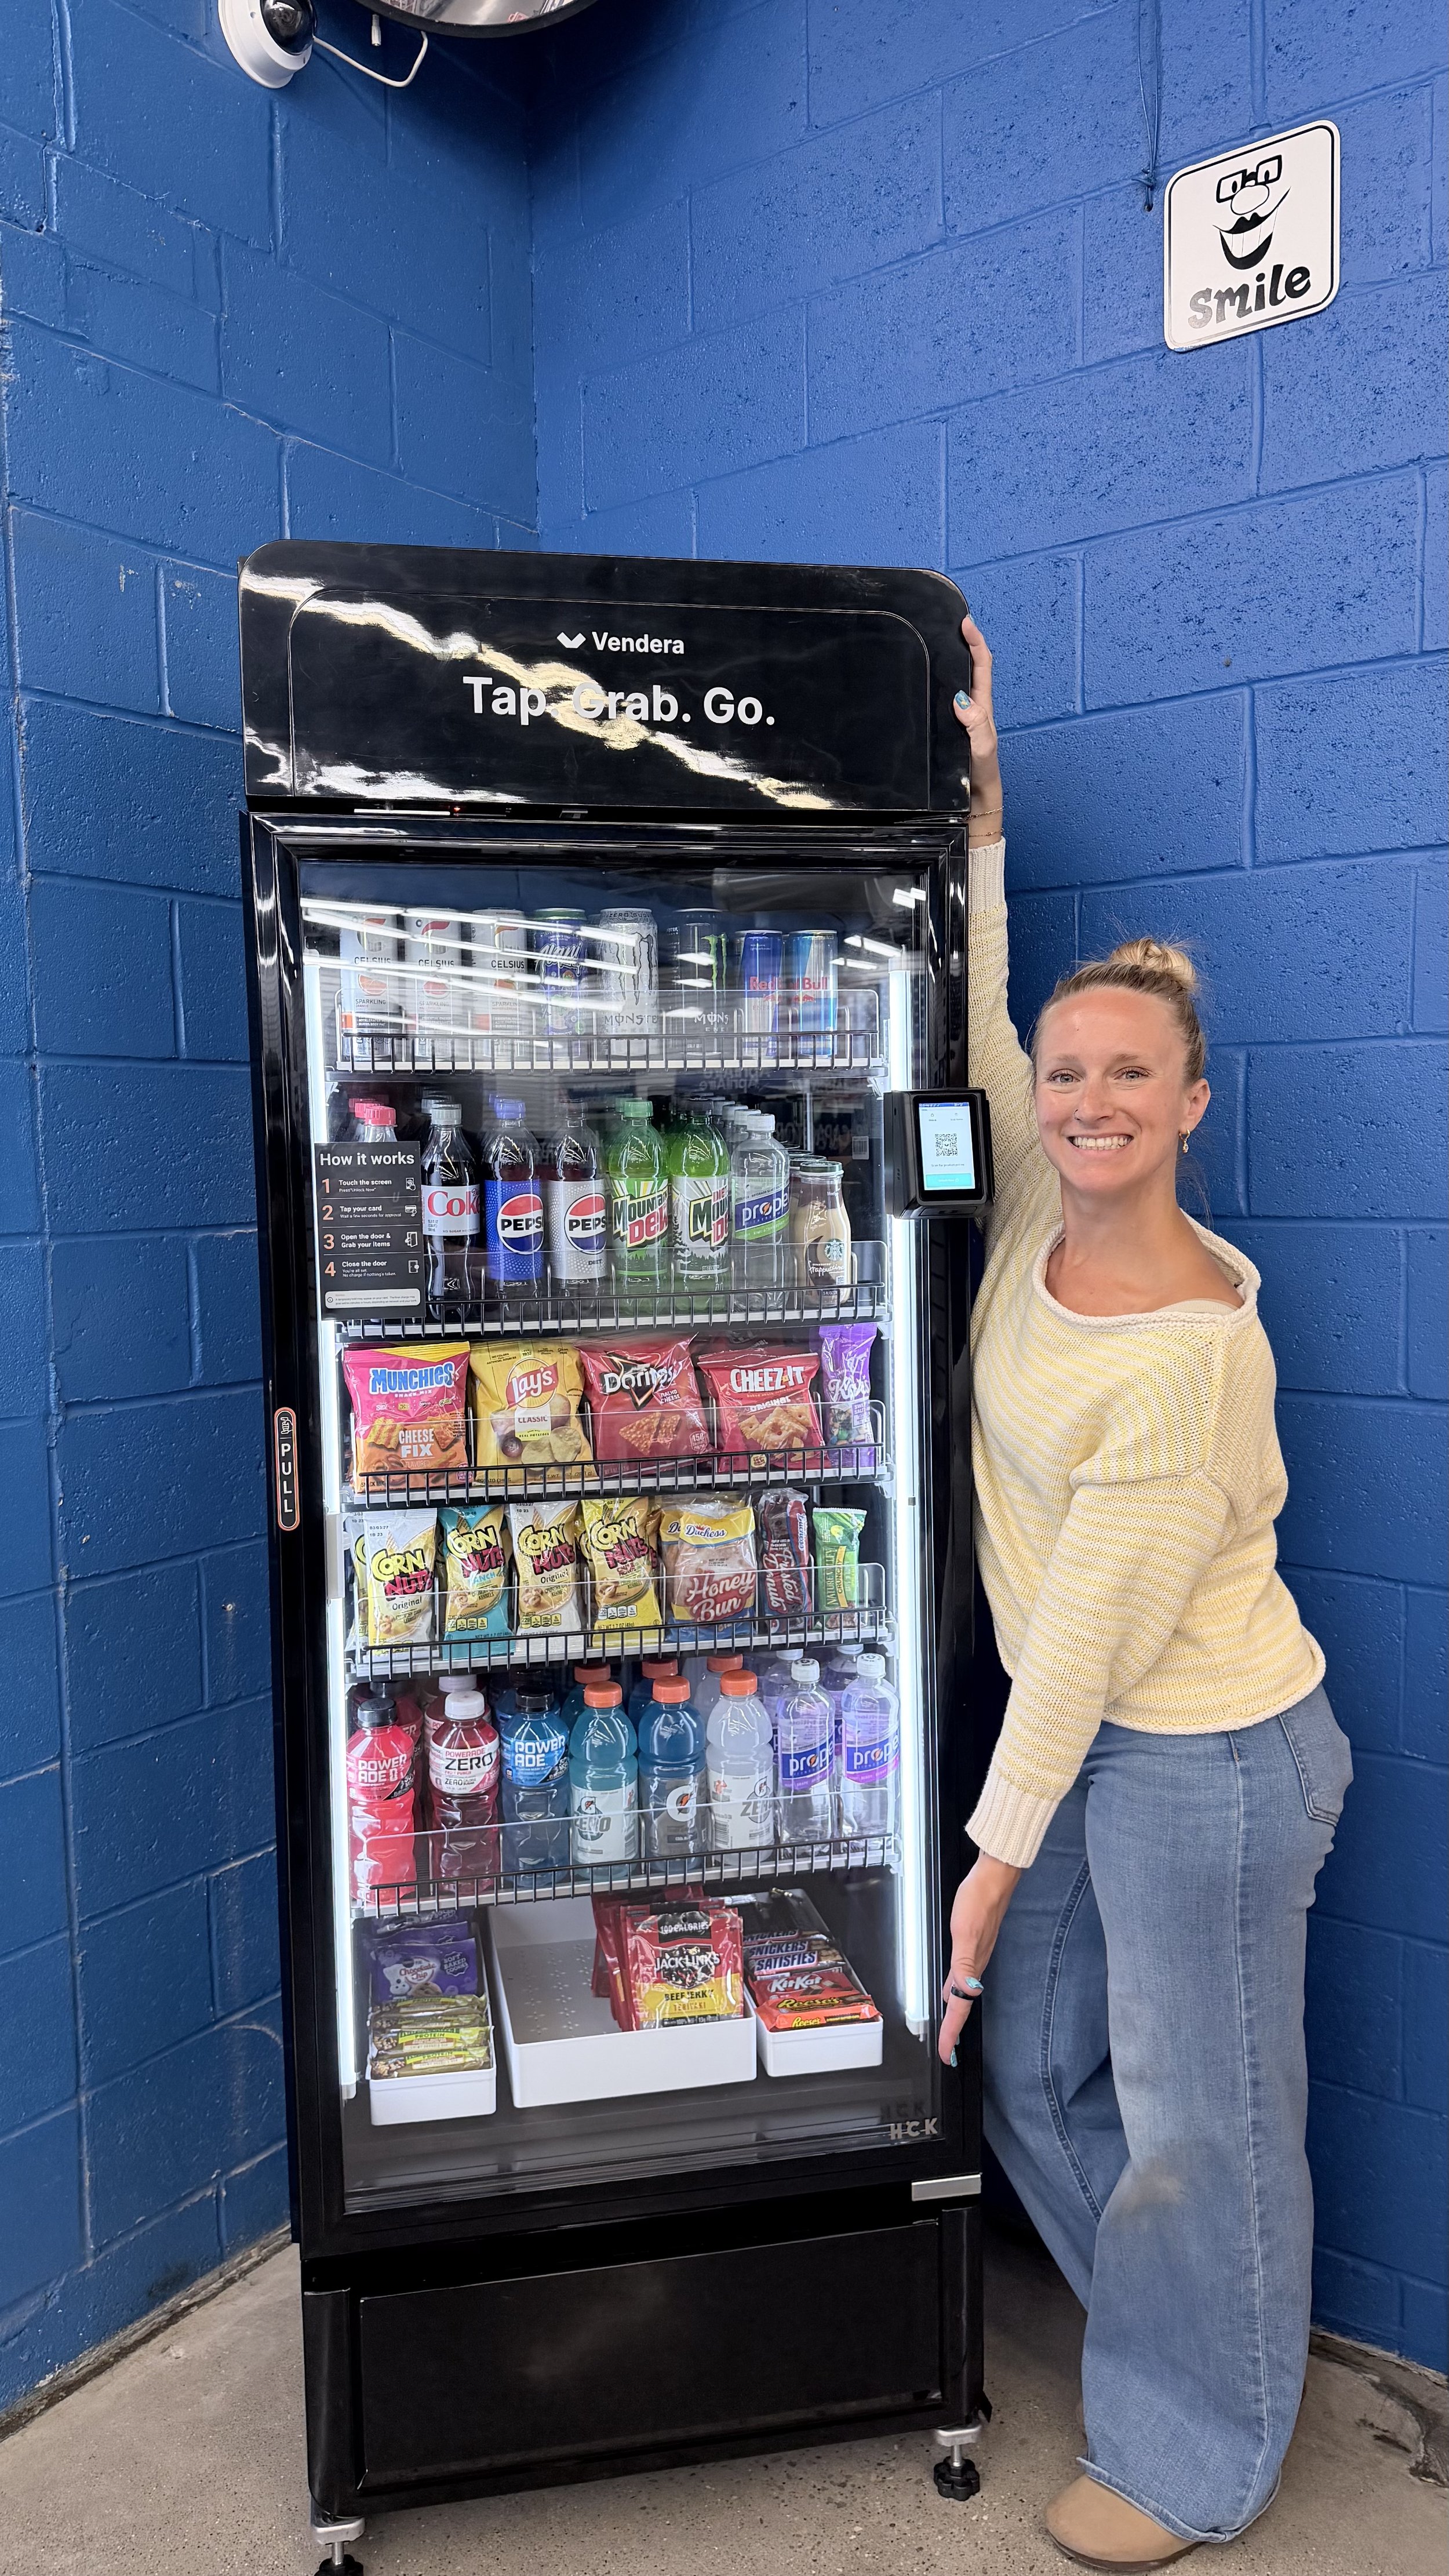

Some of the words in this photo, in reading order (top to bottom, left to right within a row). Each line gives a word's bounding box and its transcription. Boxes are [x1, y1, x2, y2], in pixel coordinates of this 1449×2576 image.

[592, 631, 685, 654] Vendera
[463, 676, 559, 726] Tap.
[573, 682, 691, 723] Grab.
[704, 687, 776, 726] Go.
[418, 959, 454, 967] CELSIUS
[491, 960, 525, 969] CELSIUS
[749, 976, 776, 990] Red
[802, 977, 828, 990] Bull
[320, 1153, 352, 1166] How
[356, 1152, 367, 1165] it
[370, 1151, 415, 1165] works
[322, 1178, 330, 1194] 1
[322, 1205, 334, 1220] 2
[501, 1217, 544, 1231] PEPS
[569, 1216, 606, 1232] PEPS
[323, 1234, 335, 1250] 3
[325, 1261, 336, 1277] 4
[512, 1367, 554, 1403] Lay's
[603, 1366, 673, 1393] Doritos
[660, 1393, 681, 1404] CHEESE
[750, 1396, 792, 1412] ORIGINAL
[518, 1415, 548, 1423] CLASSIC
[398, 1428, 435, 1445] CHEESE
[401, 1443, 433, 1458] FIX
[281, 1443, 293, 1513] PULL
[589, 1516, 638, 1551] CORN
[685, 1525, 726, 1538] Duchess
[447, 1527, 497, 1559] CORN
[518, 1524, 565, 1556] CORN
[372, 1549, 425, 1581] CORN
[533, 1543, 575, 1575] NUTS
[540, 1569, 569, 1584] Original
[686, 1570, 756, 1603] Honey
[826, 1574, 838, 1605] NATURE
[392, 1597, 422, 1611] Original
[693, 1597, 741, 1622] Bun
[515, 1734, 566, 1753] POWER
[445, 1748, 486, 1758] POWERADE
[514, 1753, 546, 1767] ADE
[358, 1753, 407, 1771] POWER
[445, 1752, 493, 1771] ZERO
[358, 1770, 387, 1783] ADE
[445, 1778, 463, 1786] ZERO
[673, 1921, 709, 1932] CALORIES
[749, 1941, 806, 1956] SNICKERS
[443, 1953, 461, 1964] SOFT
[443, 1957, 467, 1970] BAKED
[654, 1957, 684, 1971] JACK
[756, 1952, 816, 1971] SATISFIES
[399, 1962, 437, 1977] Chocolate
[411, 1971, 428, 1980] Chip
[446, 1962, 468, 1974] COOKIES
[664, 1992, 685, 2001] BEEF
[673, 2002, 706, 2011] TERIYAKI
